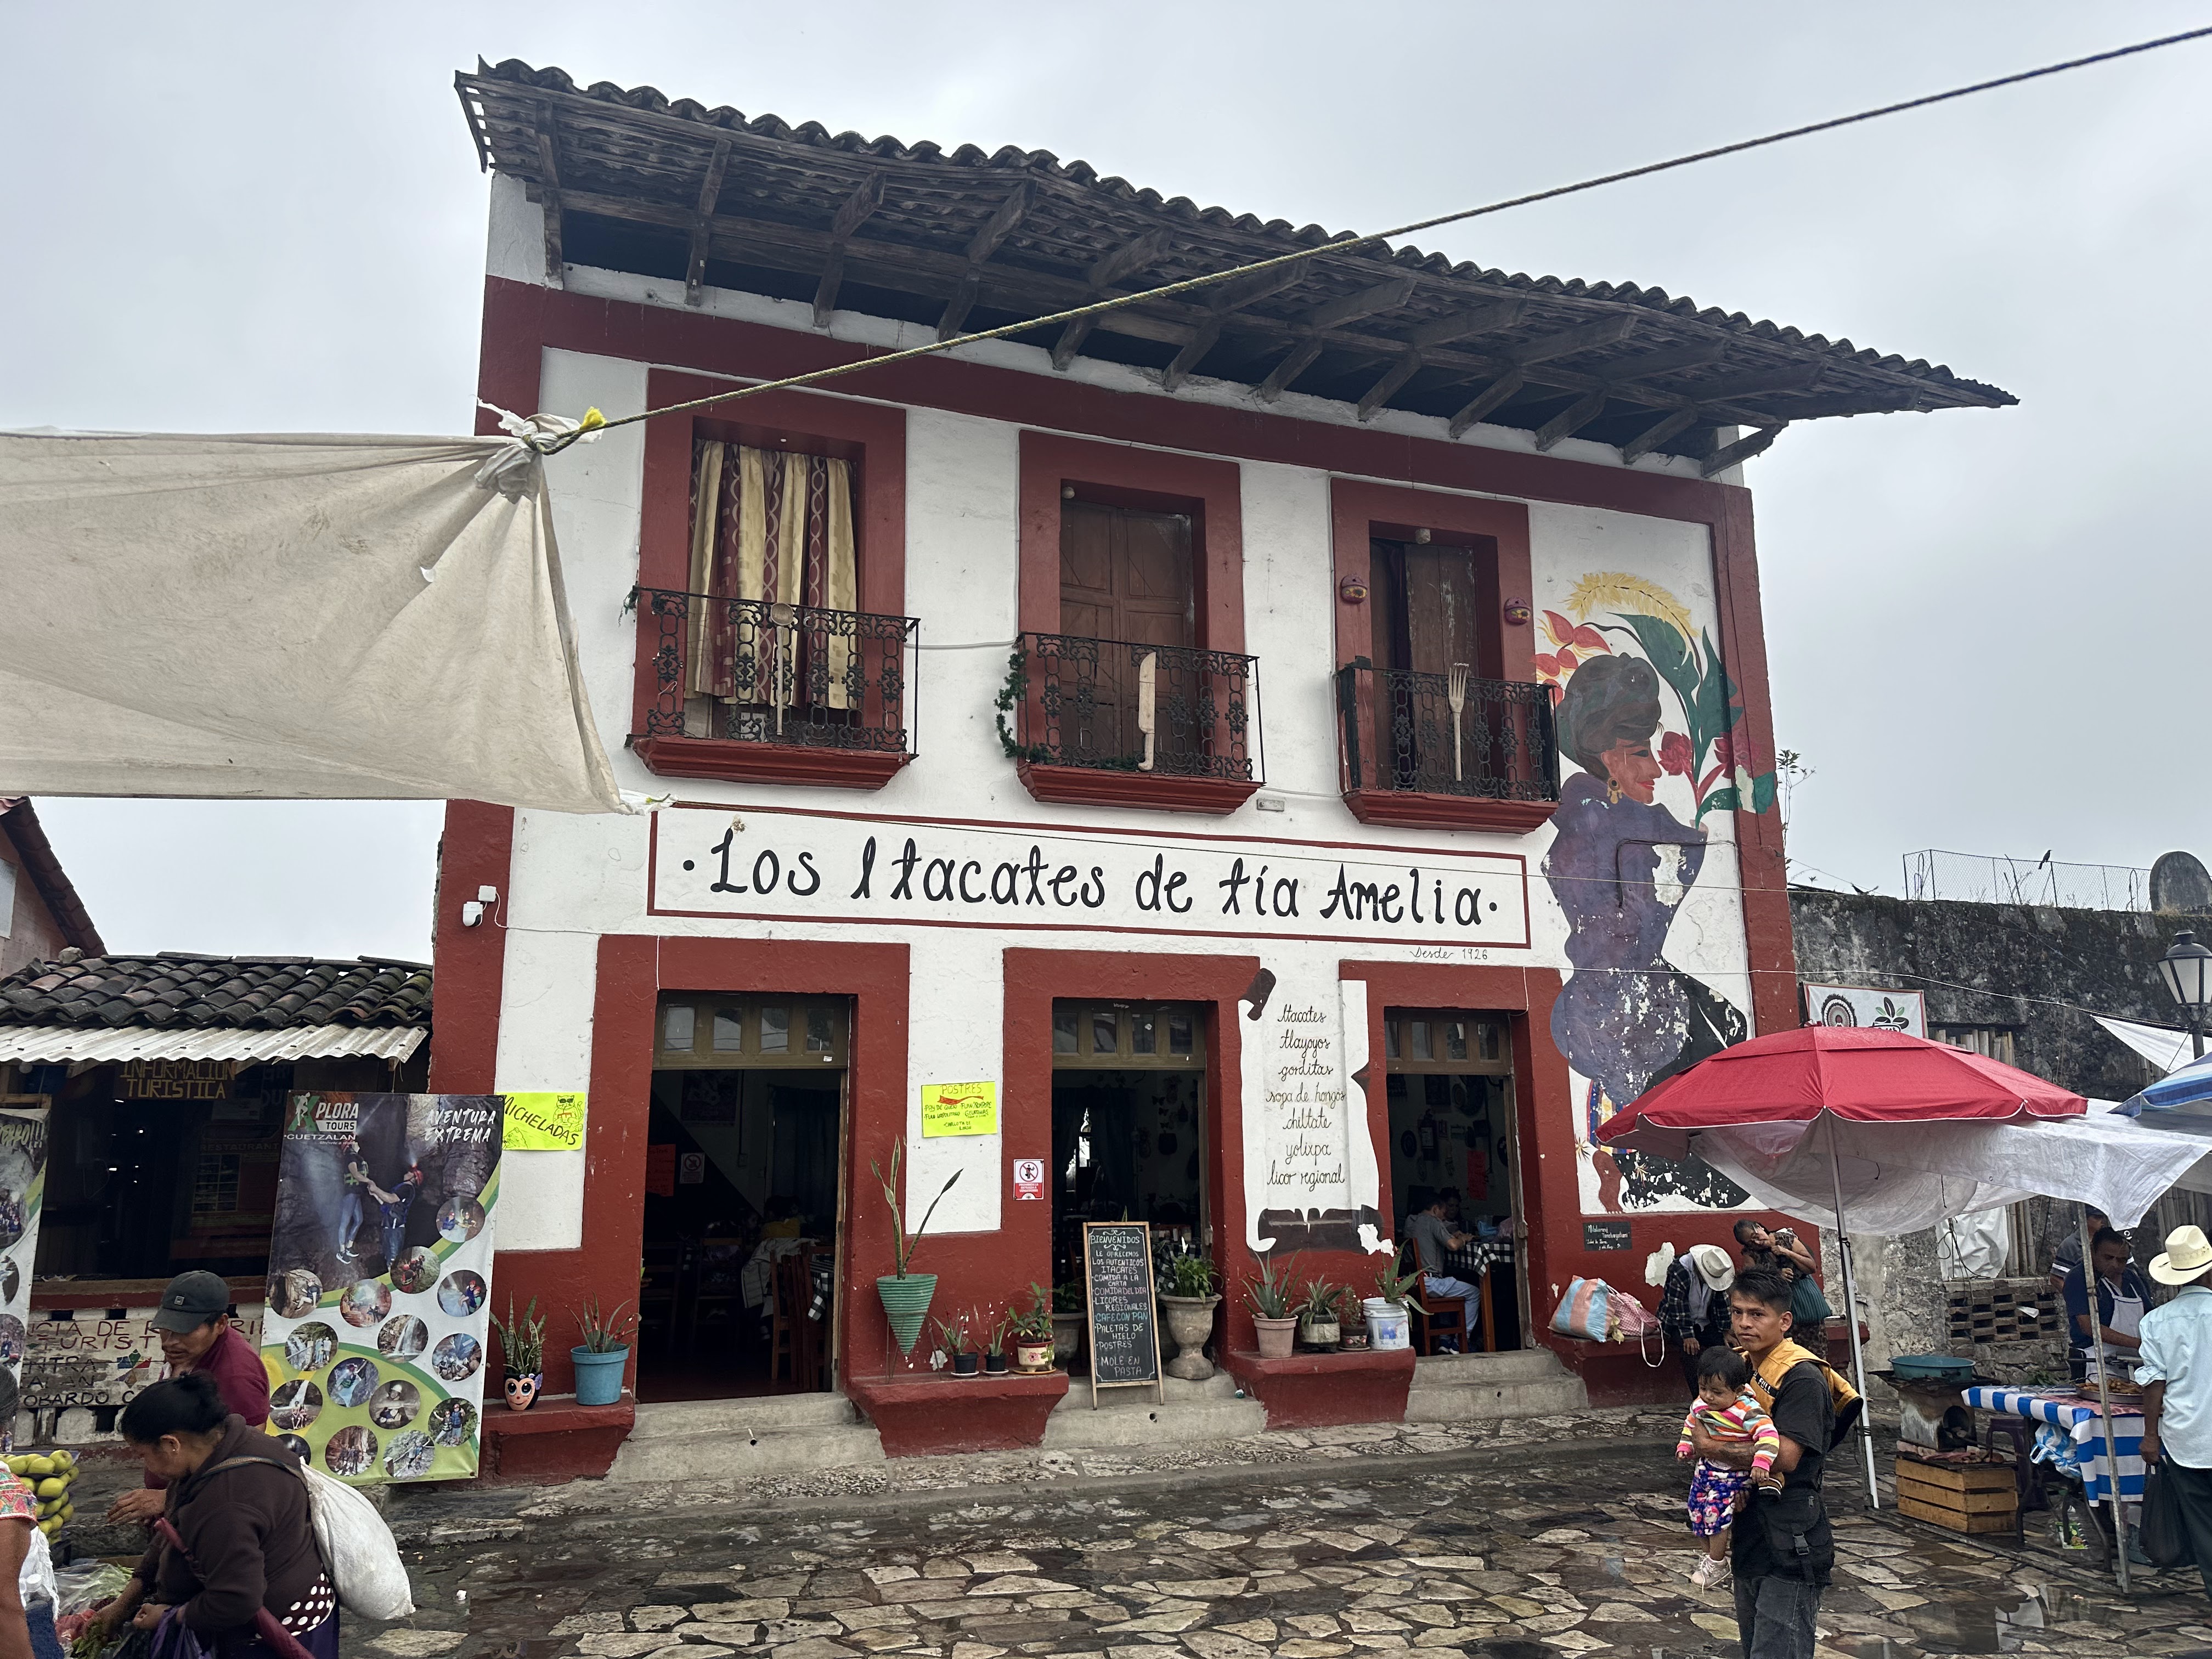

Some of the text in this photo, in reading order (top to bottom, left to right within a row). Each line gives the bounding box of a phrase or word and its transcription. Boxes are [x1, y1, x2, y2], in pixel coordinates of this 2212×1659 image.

[710, 827, 821, 896] Los
[1135, 853, 1193, 913] de
[1219, 857, 1300, 918] tía
[1319, 863, 1482, 926] Amelia
[1409, 946, 1488, 960] Desde 1926
[1280, 1029, 1330, 1058] tlayoyos
[1278, 1059, 1333, 1082] gorditas
[127, 1079, 225, 1099] TURISTICA
[940, 1084, 982, 1094] POSTRES
[1266, 1082, 1346, 1109] sopa de hongos
[425, 1108, 496, 1126] AVENTURA
[504, 1094, 579, 1146] MICHELADAS
[1283, 1107, 1332, 1130] chiltate
[326, 1122, 355, 1130] TOURS
[424, 1126, 492, 1143] EXTREMA
[1285, 1133, 1331, 1165] yolixpa
[1267, 1160, 1345, 1192] licor regional
[1090, 1235, 1140, 1244] BIENVENIDOS
[1106, 1258, 1144, 1266] AUTENTICOS
[1101, 1266, 1138, 1274] ITACATES
[1094, 1296, 1128, 1305] LICORES
[1105, 1302, 1148, 1312] REGIONALES
[1096, 1311, 1148, 1322] CAFE CON PAN
[98, 1321, 131, 1336] DE
[1096, 1323, 1144, 1334] PALETAS DE
[1098, 1340, 1132, 1351] POSTRES
[1101, 1356, 1140, 1366] MOLE EN
[1114, 1366, 1142, 1377] PASTA
